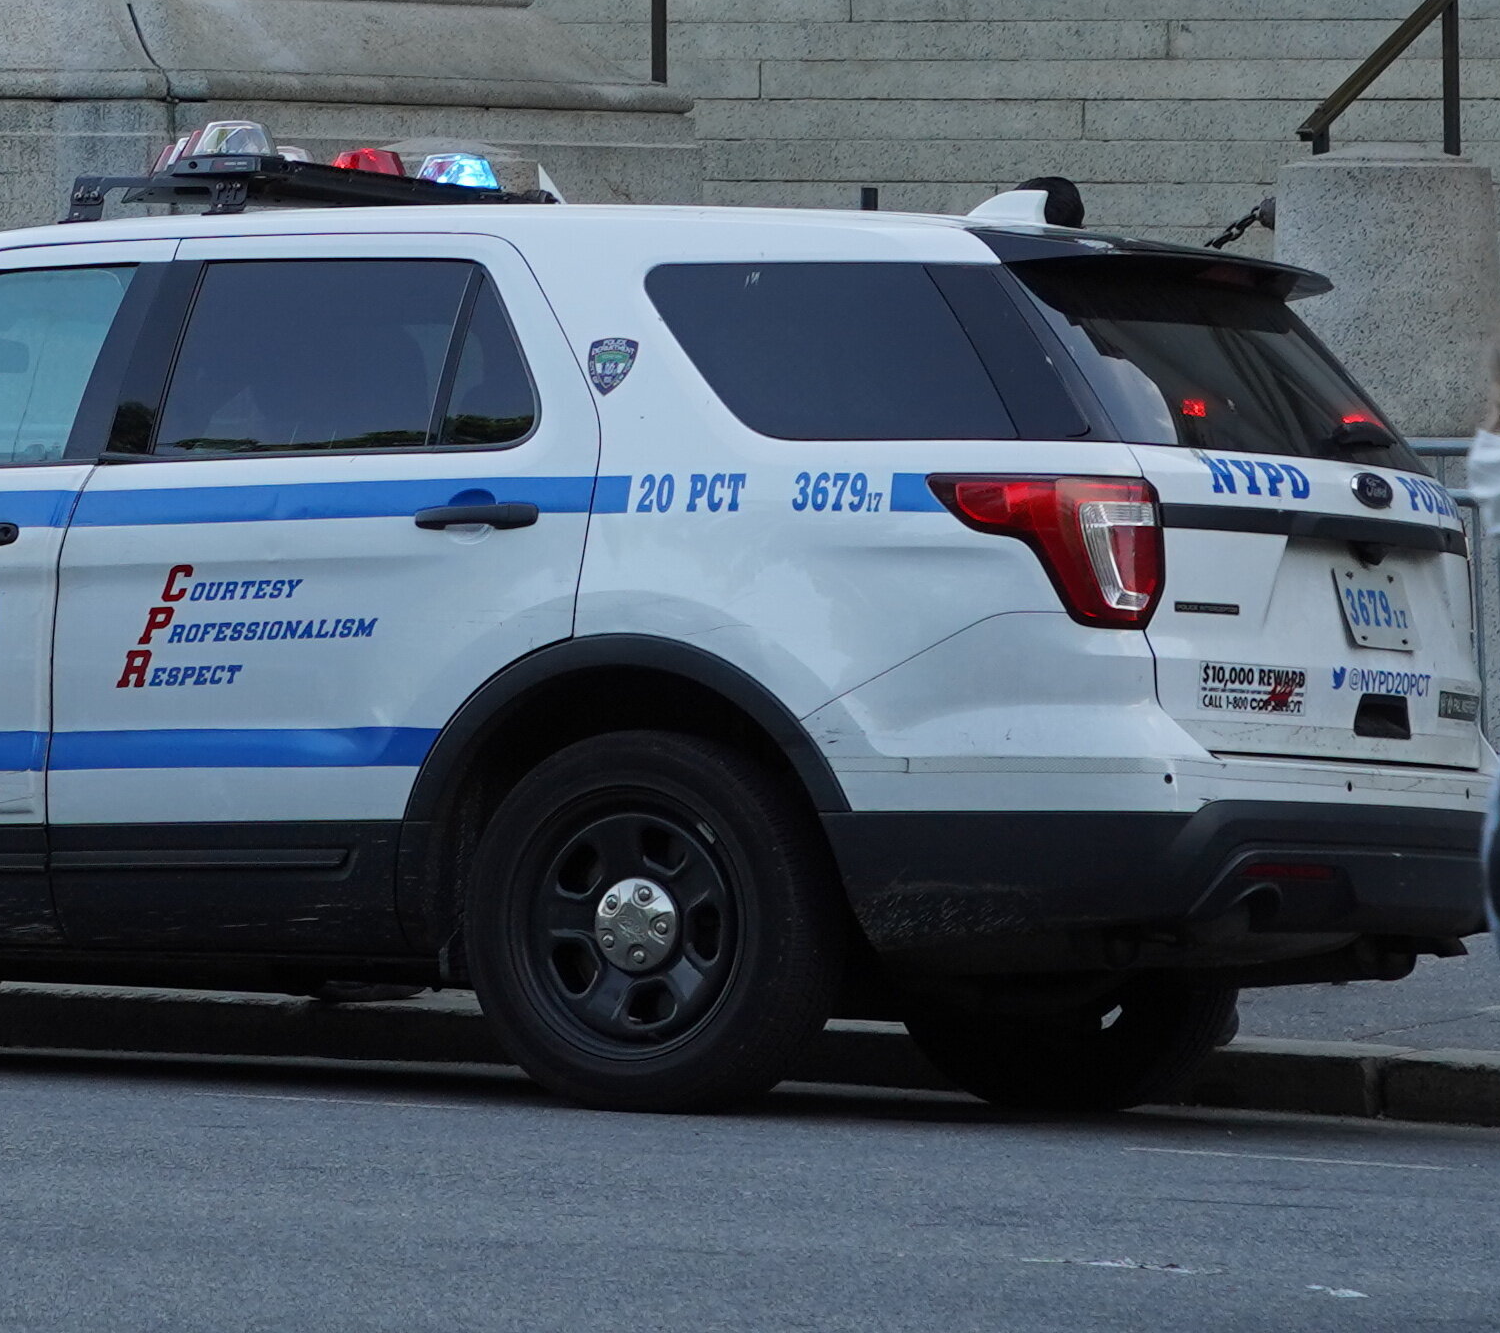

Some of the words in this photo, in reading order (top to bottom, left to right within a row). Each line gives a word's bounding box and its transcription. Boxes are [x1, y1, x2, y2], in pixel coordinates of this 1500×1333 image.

[636, 473, 675, 513] 20
[686, 472, 747, 513] PCT
[792, 471, 868, 513] 3679
[1199, 454, 1311, 499] NYPD
[1345, 588, 1392, 628] 3679
[1203, 663, 1254, 688] $10,000
[1258, 669, 1306, 689] REWARD
[1349, 668, 1431, 698] @NYPD20PCT
[1203, 694, 1223, 708] CALL
[1226, 695, 1248, 710] 1-800
